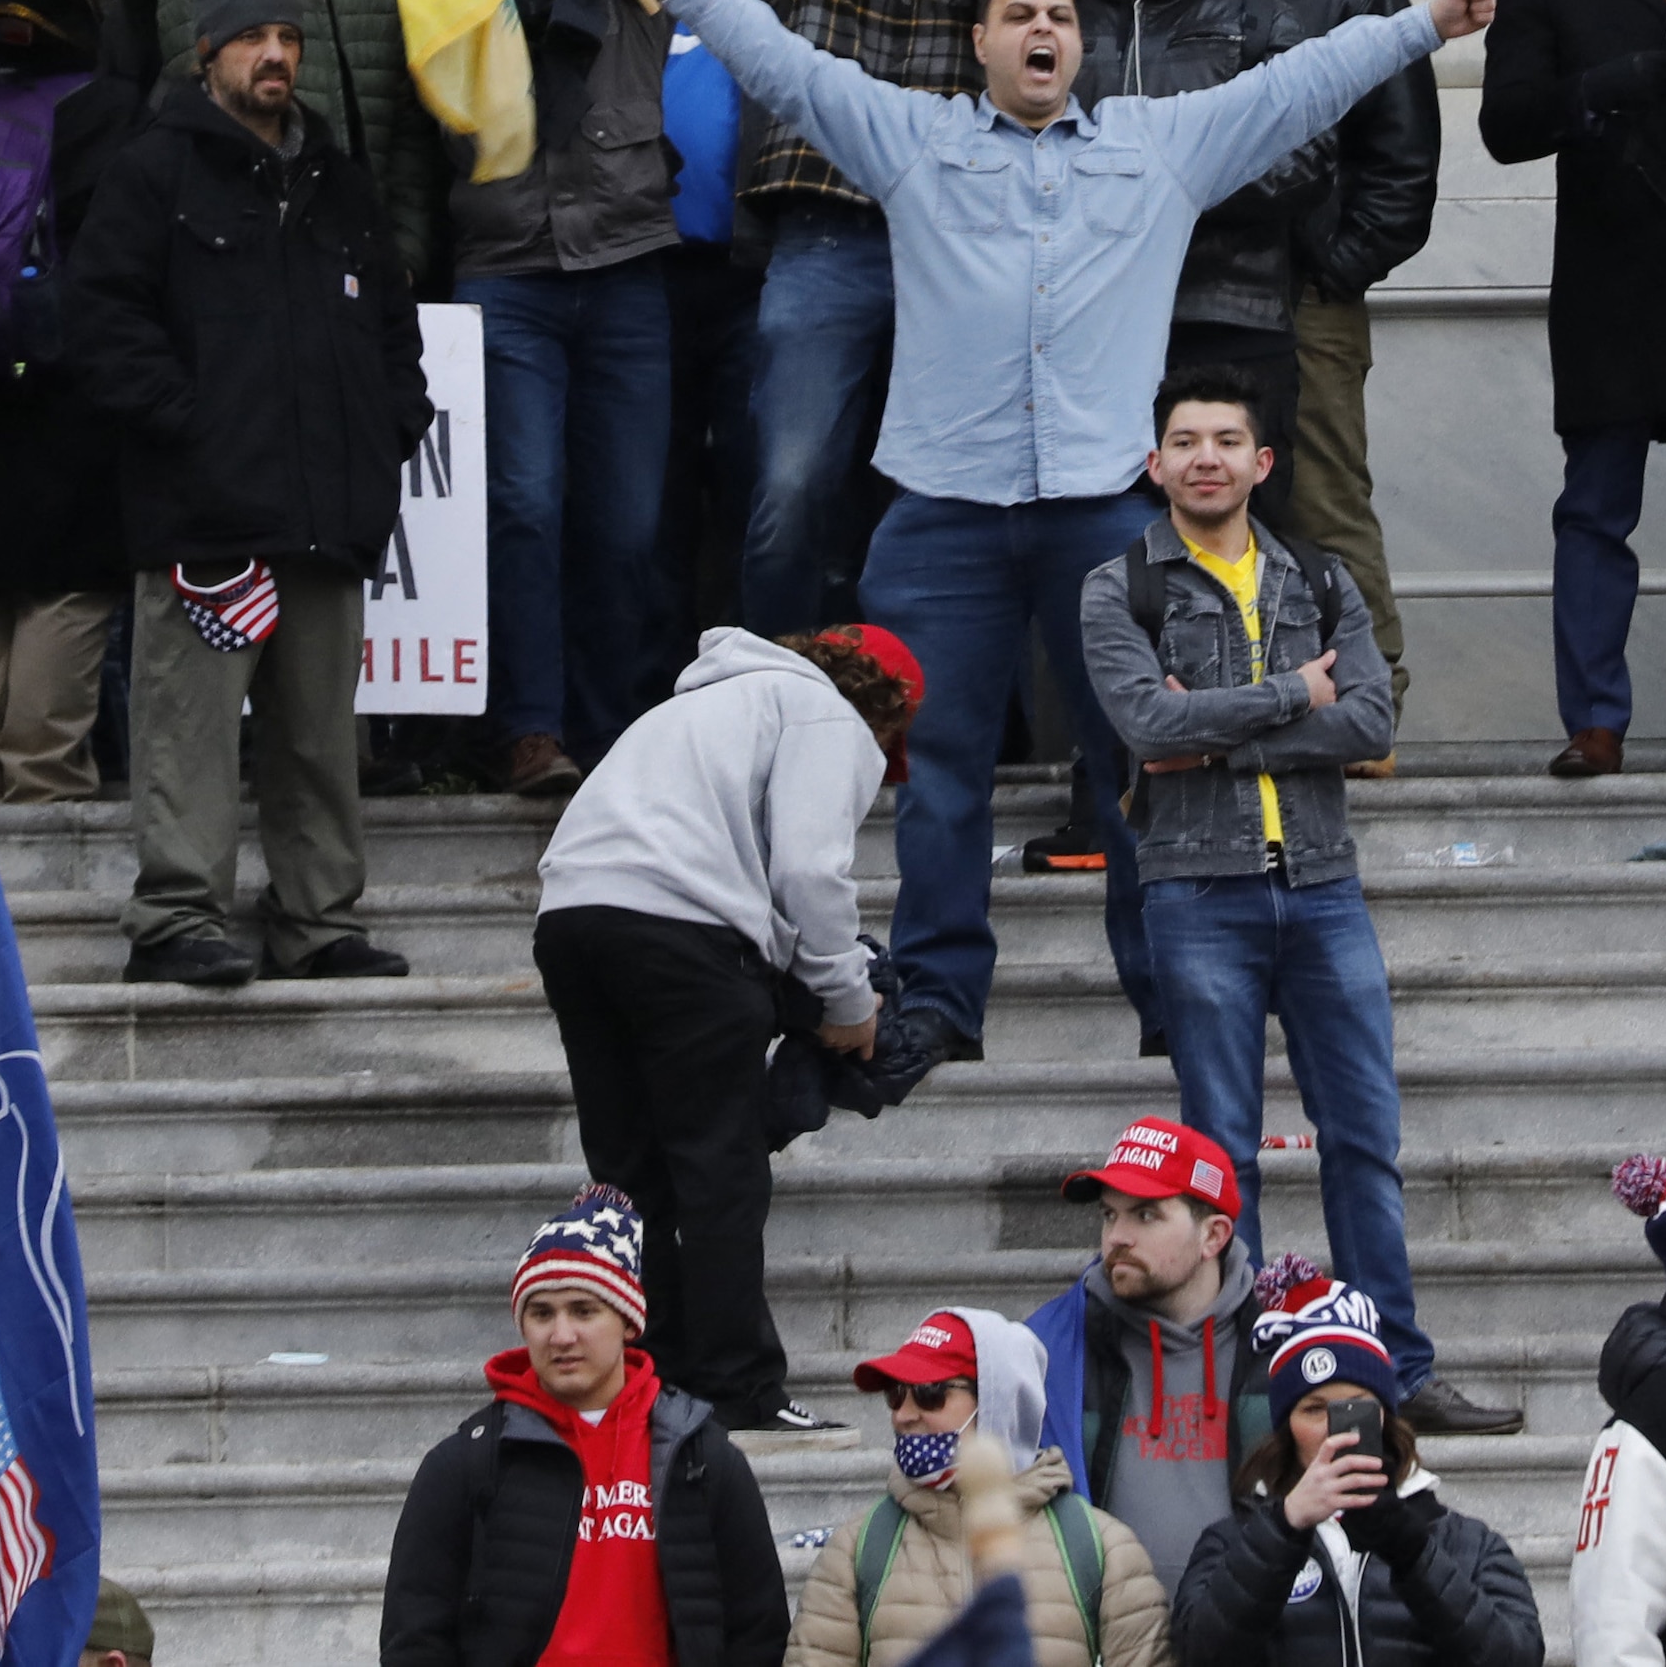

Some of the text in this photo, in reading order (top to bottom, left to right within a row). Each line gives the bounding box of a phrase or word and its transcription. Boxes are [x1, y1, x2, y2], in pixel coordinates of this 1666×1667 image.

[1119, 1146, 1166, 1172] AGAIN
[1306, 1352, 1332, 1377] 45
[1138, 1440, 1204, 1462] FACE
[581, 1479, 653, 1511] AMER
[597, 1511, 656, 1543] AGA
